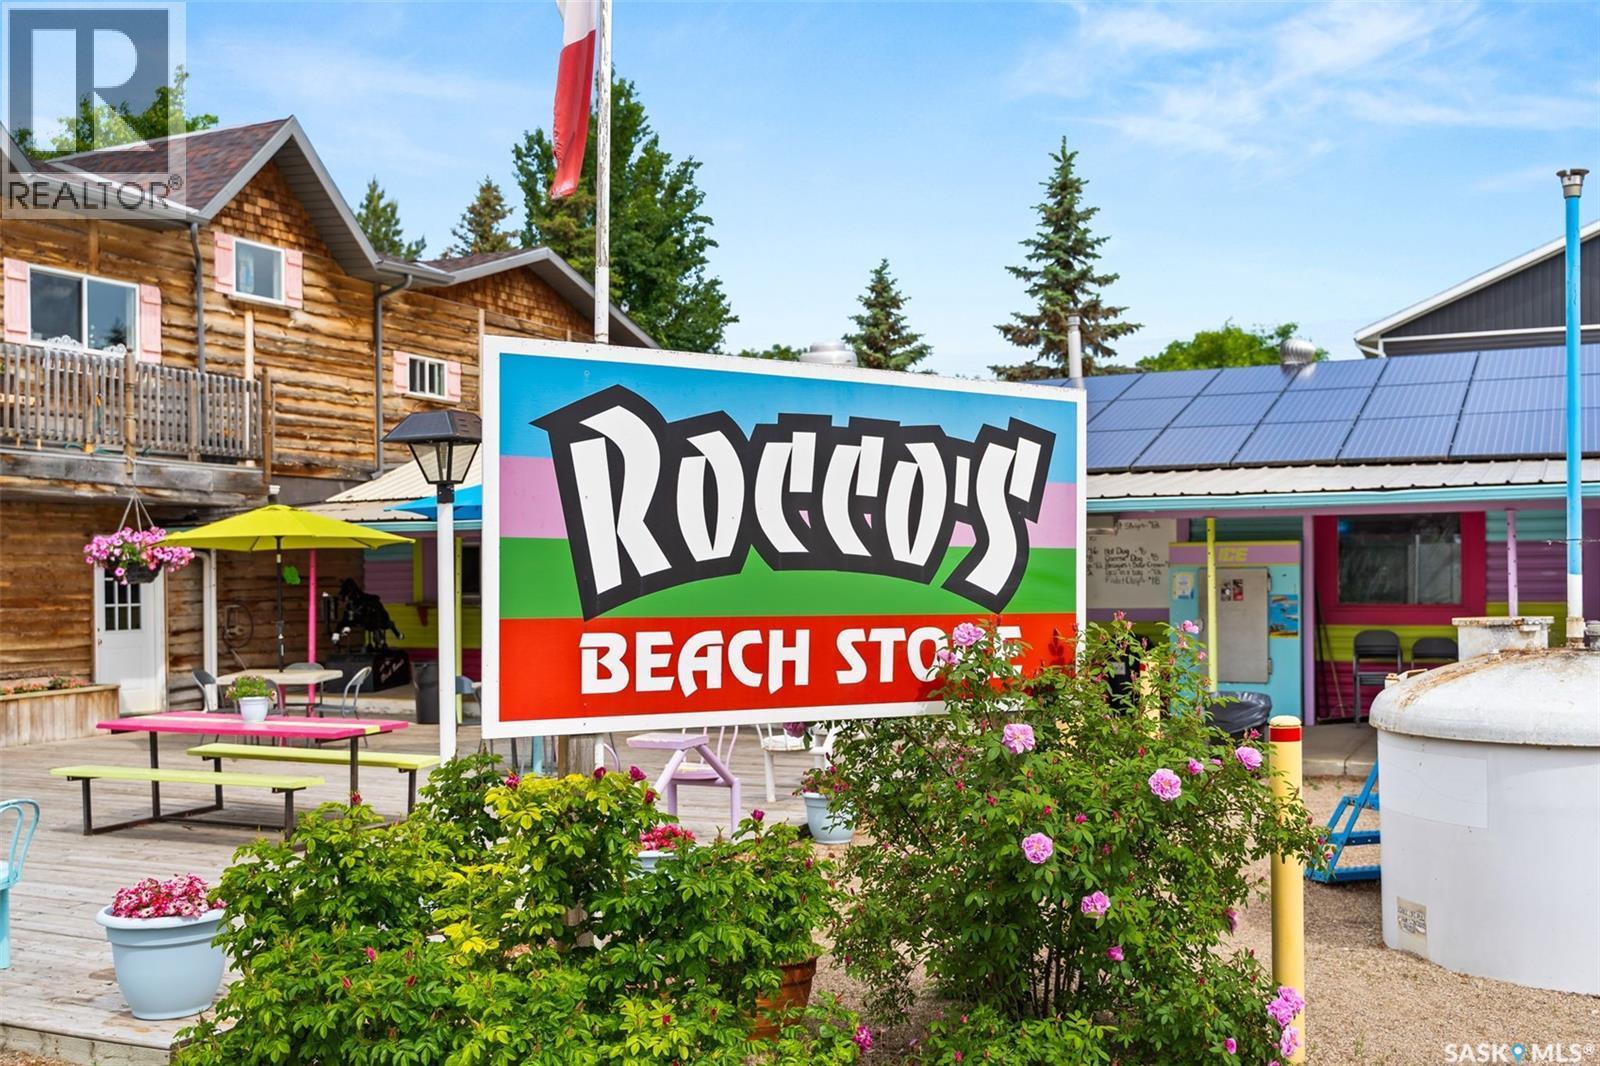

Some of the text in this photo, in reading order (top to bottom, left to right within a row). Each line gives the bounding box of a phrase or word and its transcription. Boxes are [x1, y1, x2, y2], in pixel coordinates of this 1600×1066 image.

[1218, 547, 1248, 562] ICE
[579, 626, 1023, 698] BEACH STOE
